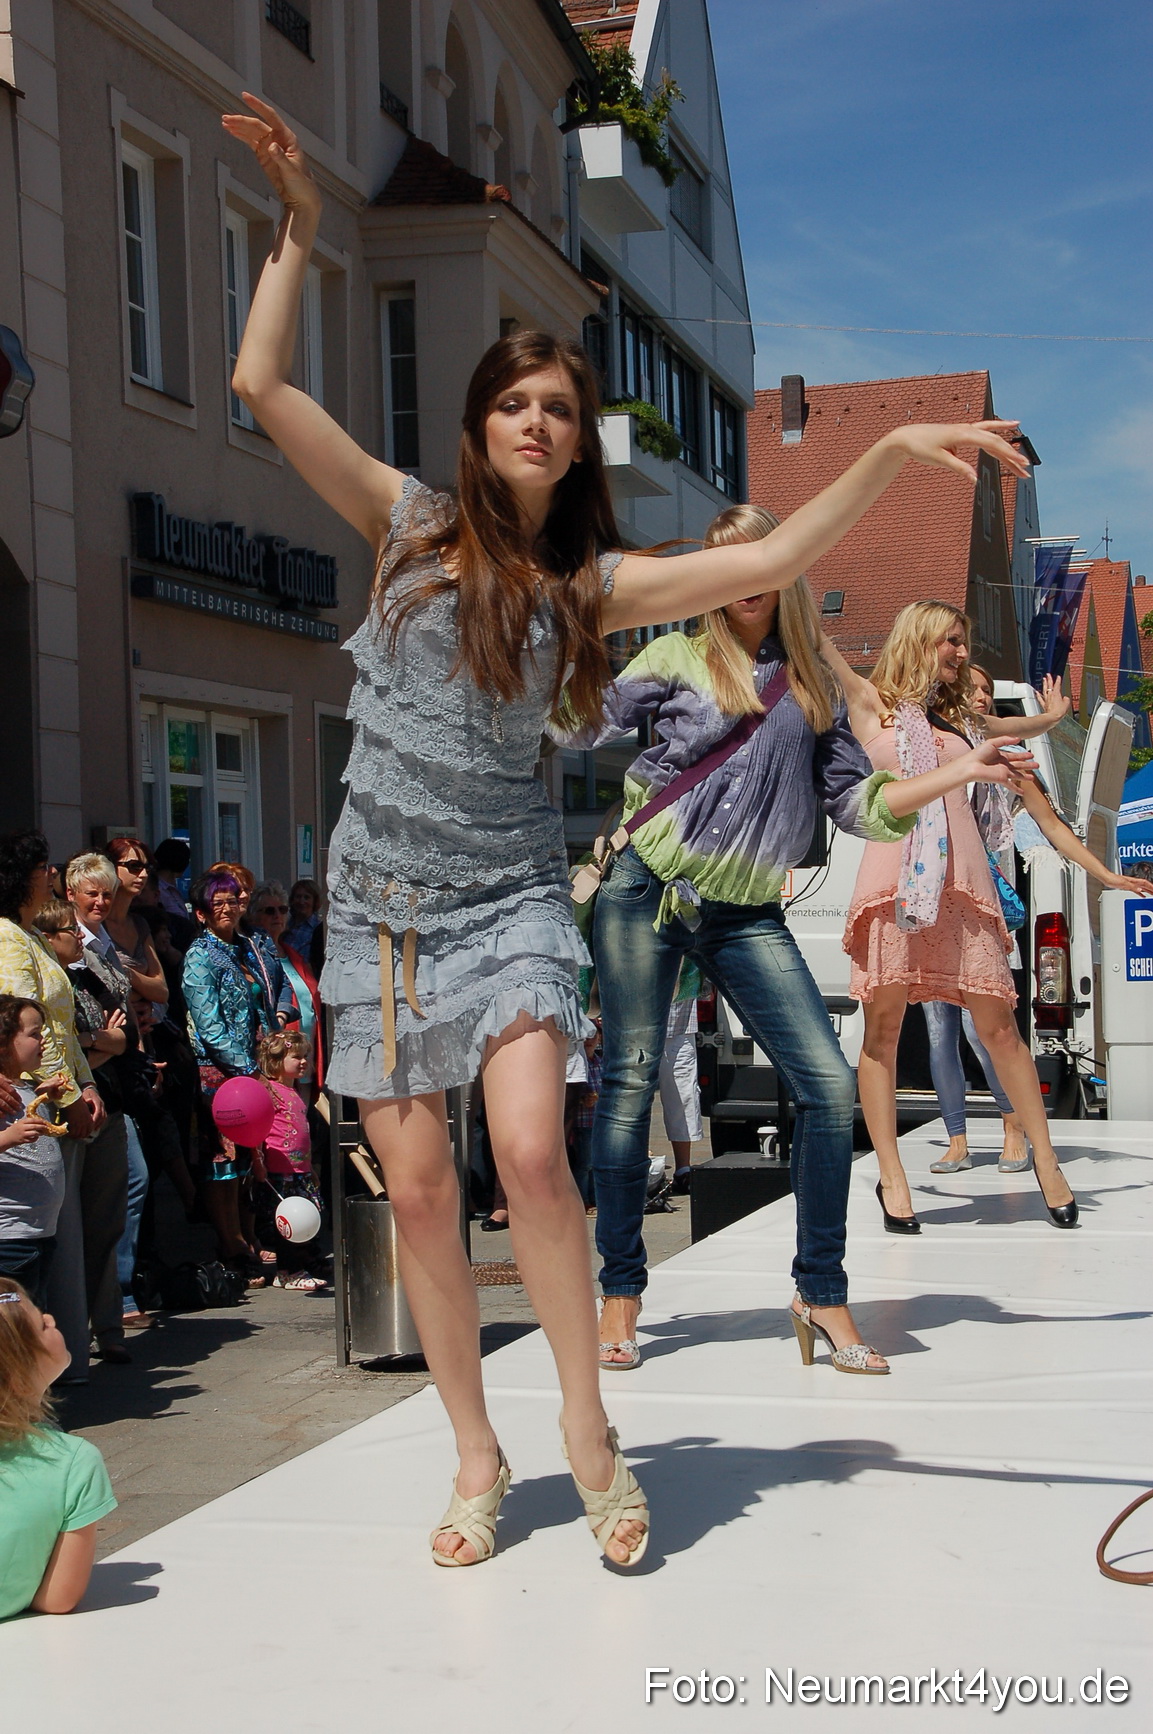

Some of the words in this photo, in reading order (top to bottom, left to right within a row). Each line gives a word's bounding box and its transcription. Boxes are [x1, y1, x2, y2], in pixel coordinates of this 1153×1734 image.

[151, 493, 267, 588] Neumarkter
[272, 536, 339, 607] Tagblatt
[155, 580, 286, 627] MITTELBAYERISCHE
[291, 616, 338, 640] ZEITUNG
[1134, 909, 1153, 947] P
